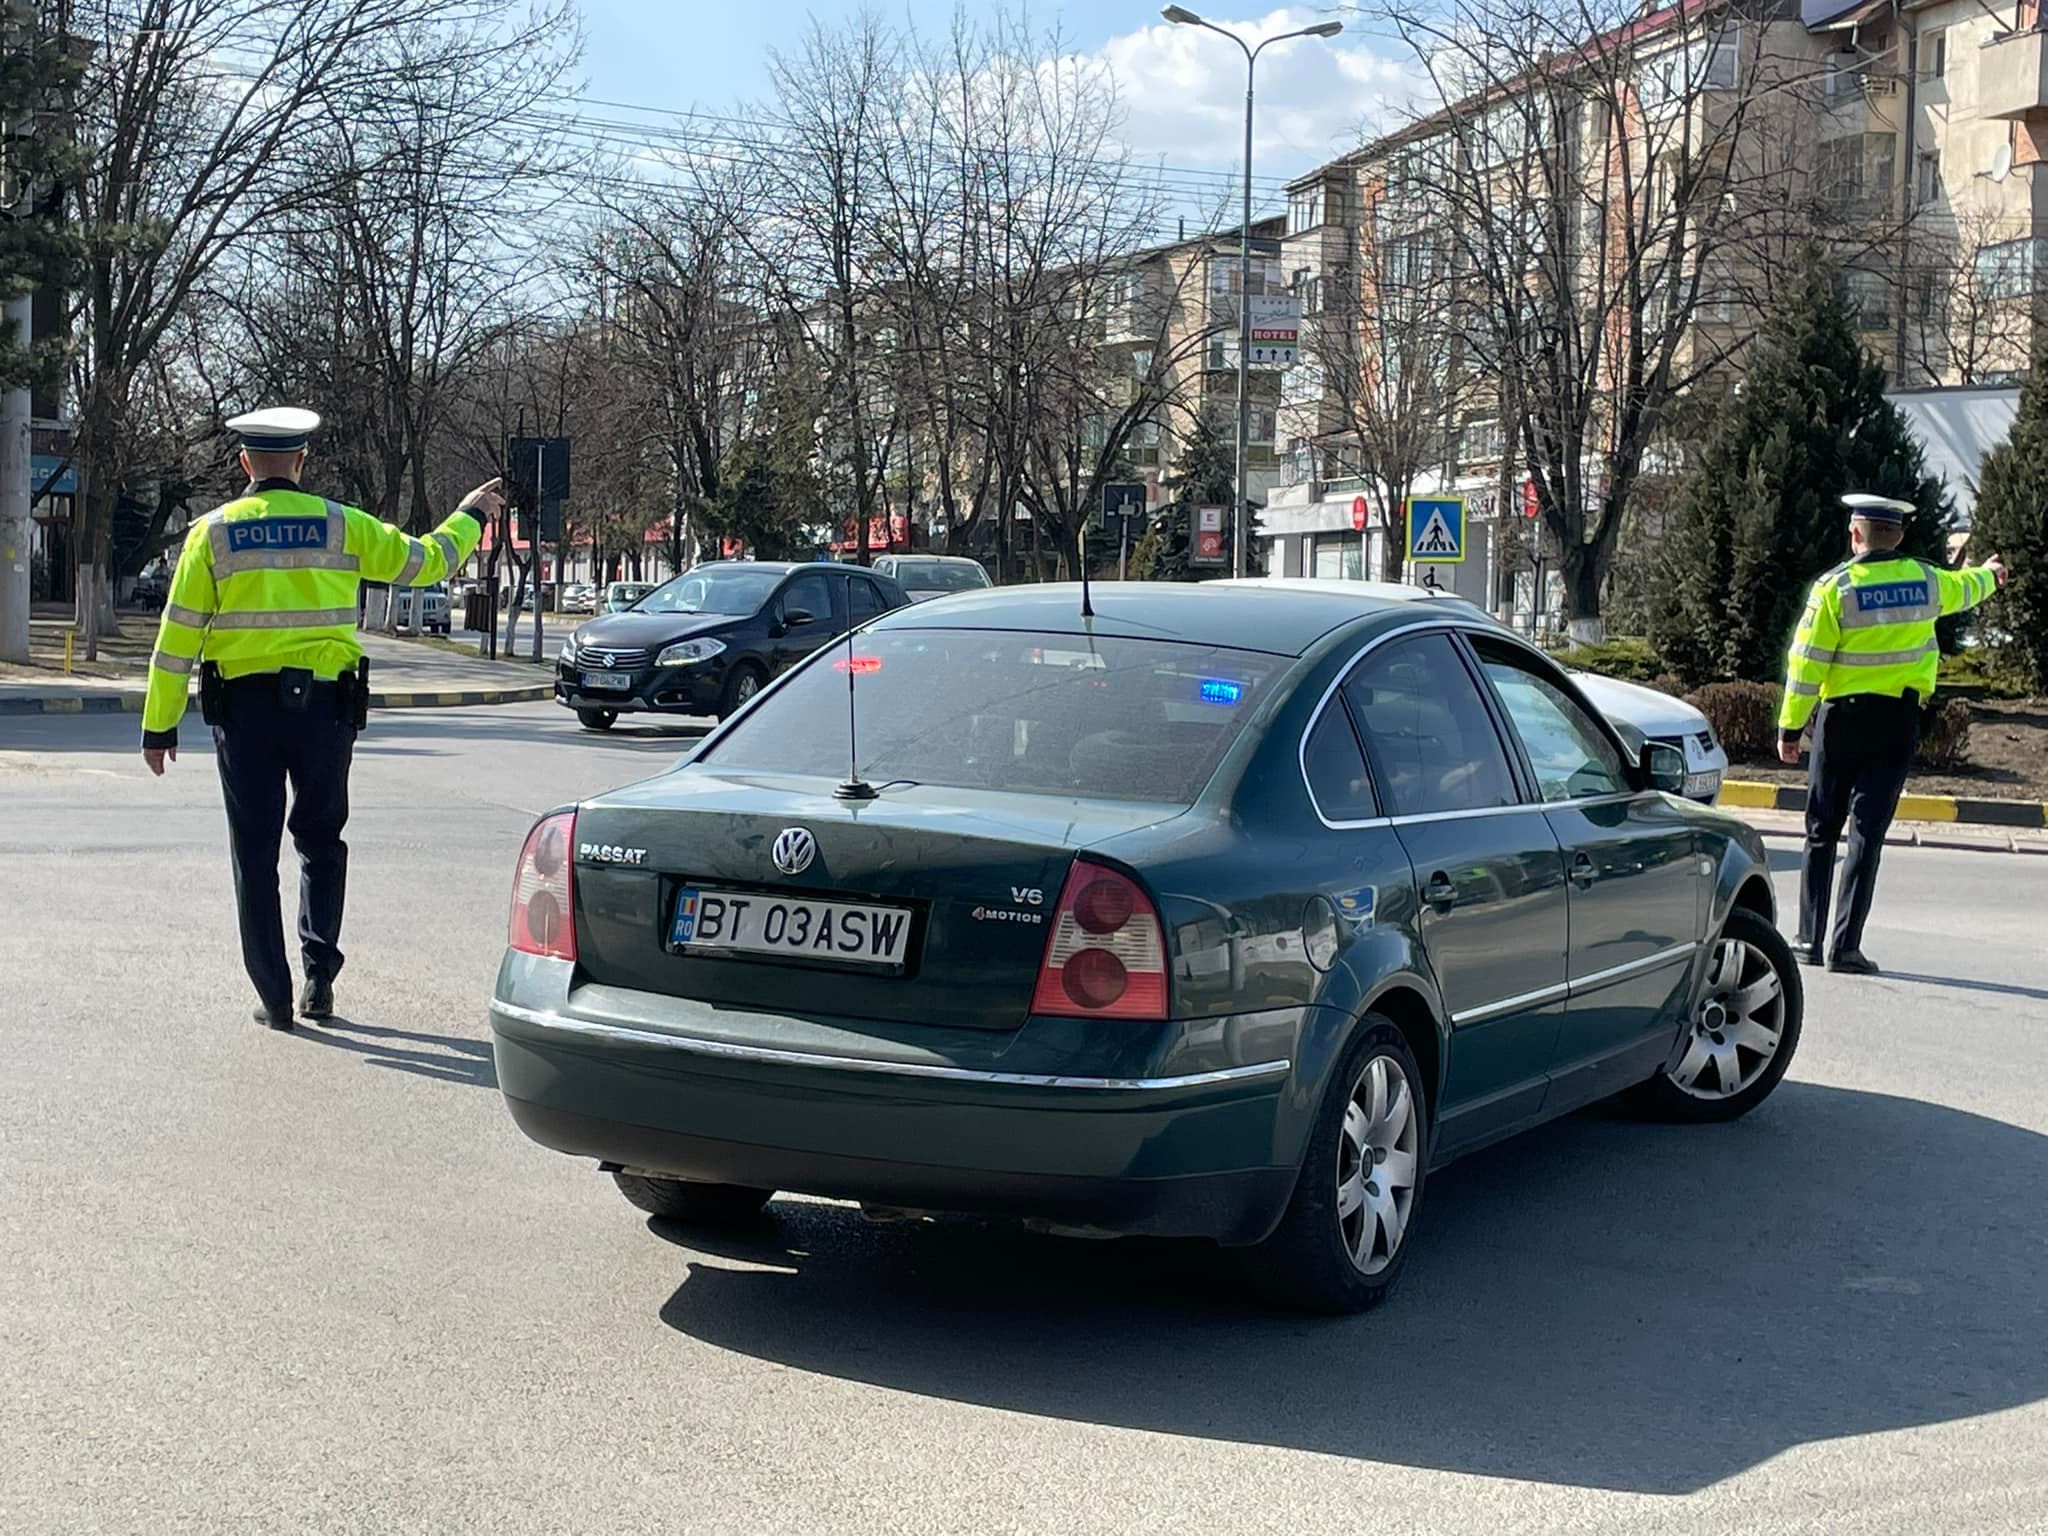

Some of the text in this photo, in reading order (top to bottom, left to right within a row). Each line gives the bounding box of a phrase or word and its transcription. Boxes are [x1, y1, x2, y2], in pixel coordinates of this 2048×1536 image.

[1253, 330, 1296, 340] HOTEL
[580, 843, 647, 865] PASSAT
[1010, 886, 1044, 905] V6
[971, 906, 1042, 924] 4MOTION
[675, 919, 694, 937] RO
[696, 897, 905, 958] BT 03ASW
